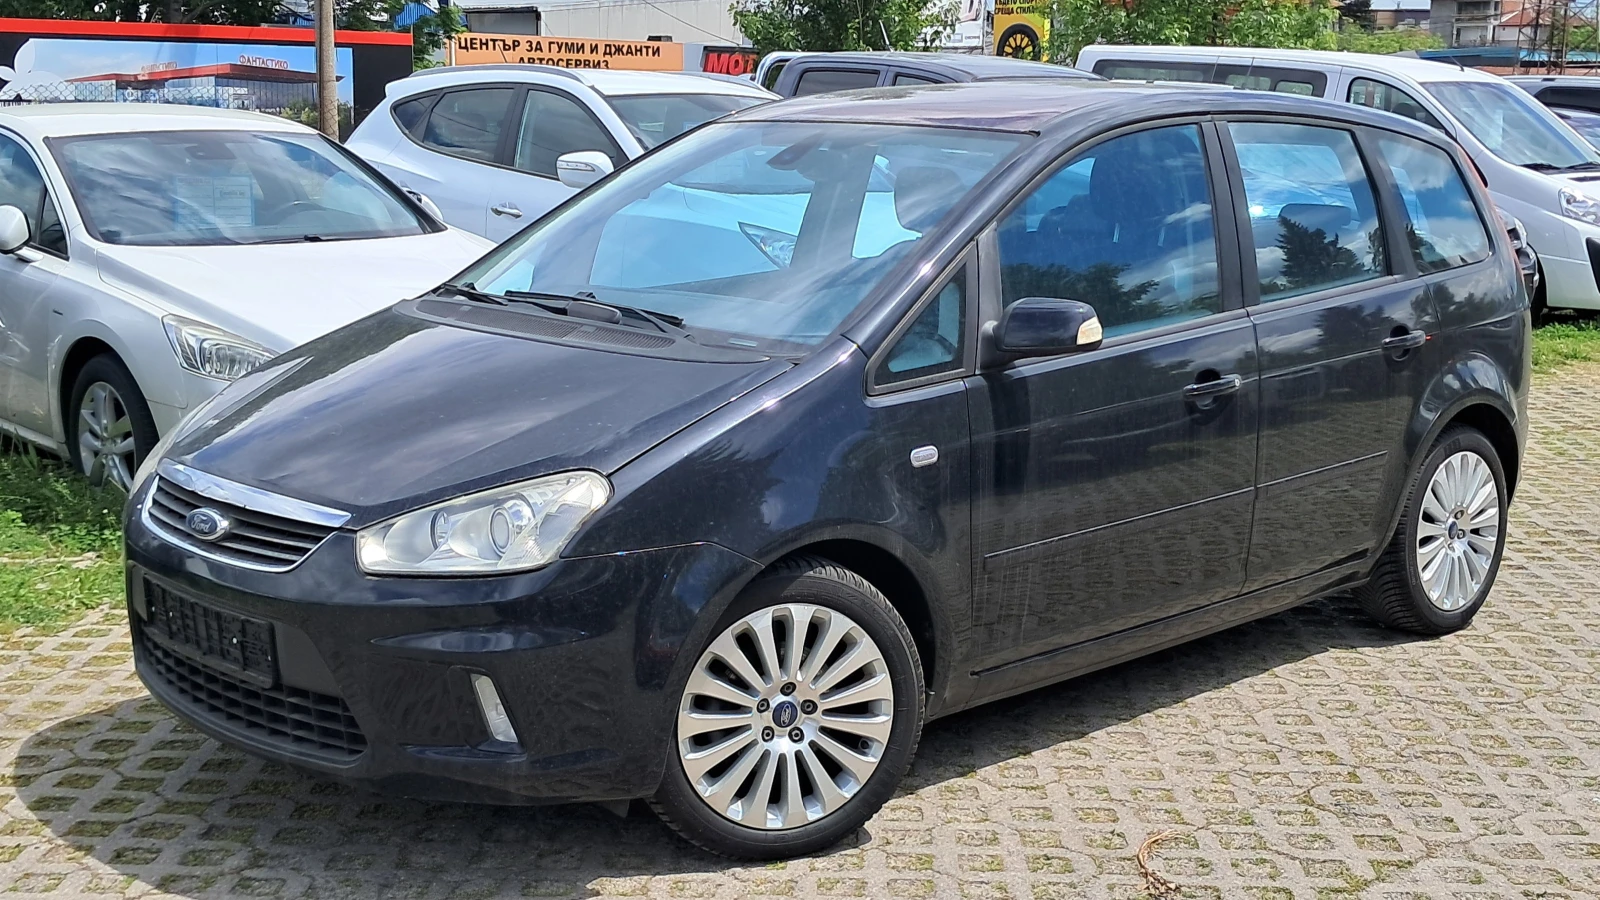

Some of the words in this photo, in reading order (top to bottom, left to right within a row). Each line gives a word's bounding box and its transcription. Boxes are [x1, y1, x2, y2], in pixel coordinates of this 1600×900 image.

[458, 37, 520, 52] ЦЕНТЪР
[525, 40, 543, 53] ЗА
[548, 41, 585, 54] ГУМИ
[590, 43, 599, 55] И
[603, 43, 660, 58] ДЖАНТИ
[239, 55, 289, 70] ФАНТАСТИКО
[191, 514, 212, 533] Ford
